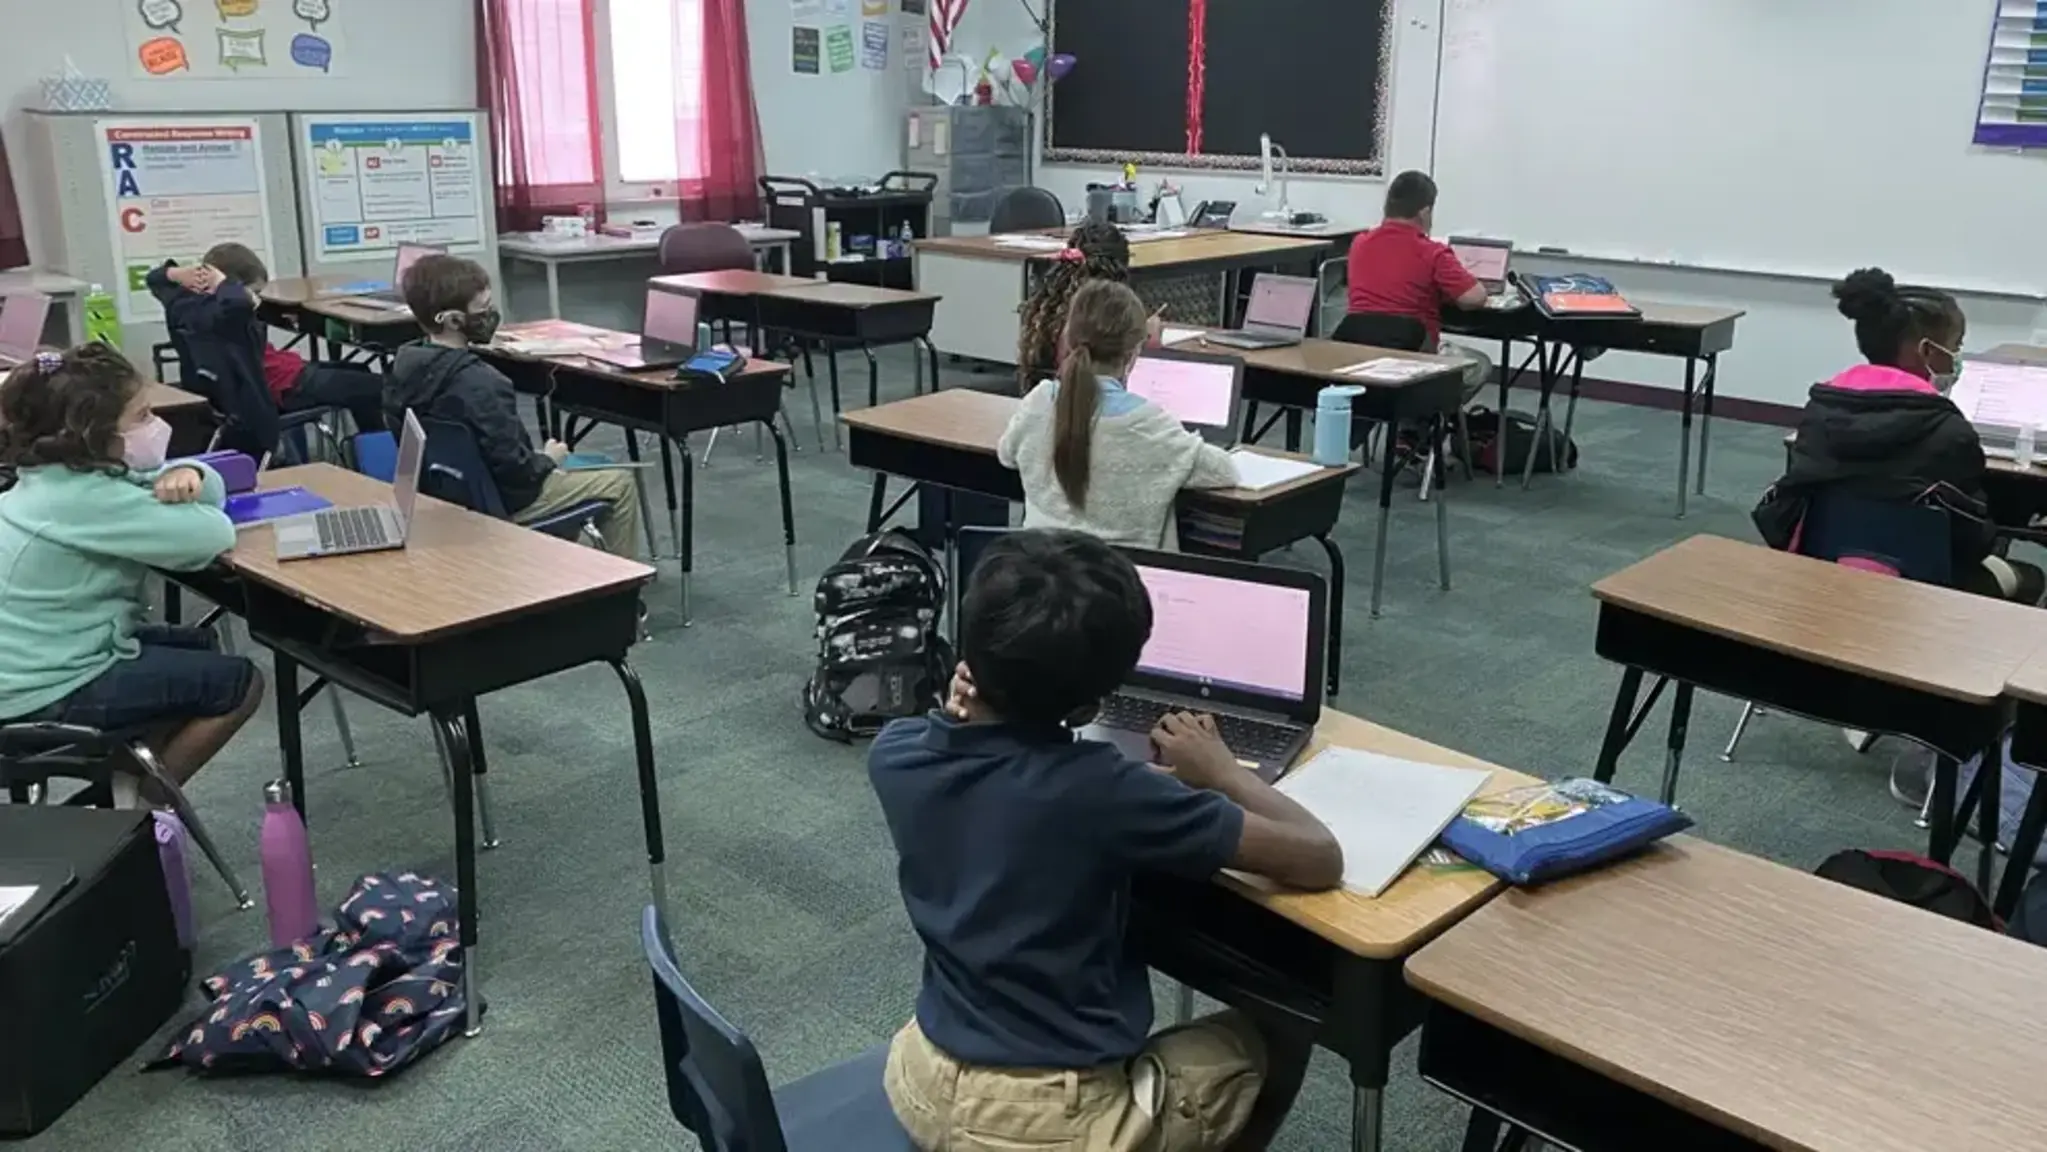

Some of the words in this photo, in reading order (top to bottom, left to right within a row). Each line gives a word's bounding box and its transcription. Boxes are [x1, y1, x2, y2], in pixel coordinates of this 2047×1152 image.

[110, 143, 137, 169] R
[118, 169, 141, 196] A
[122, 208, 147, 233] C
[128, 265, 150, 291] E
